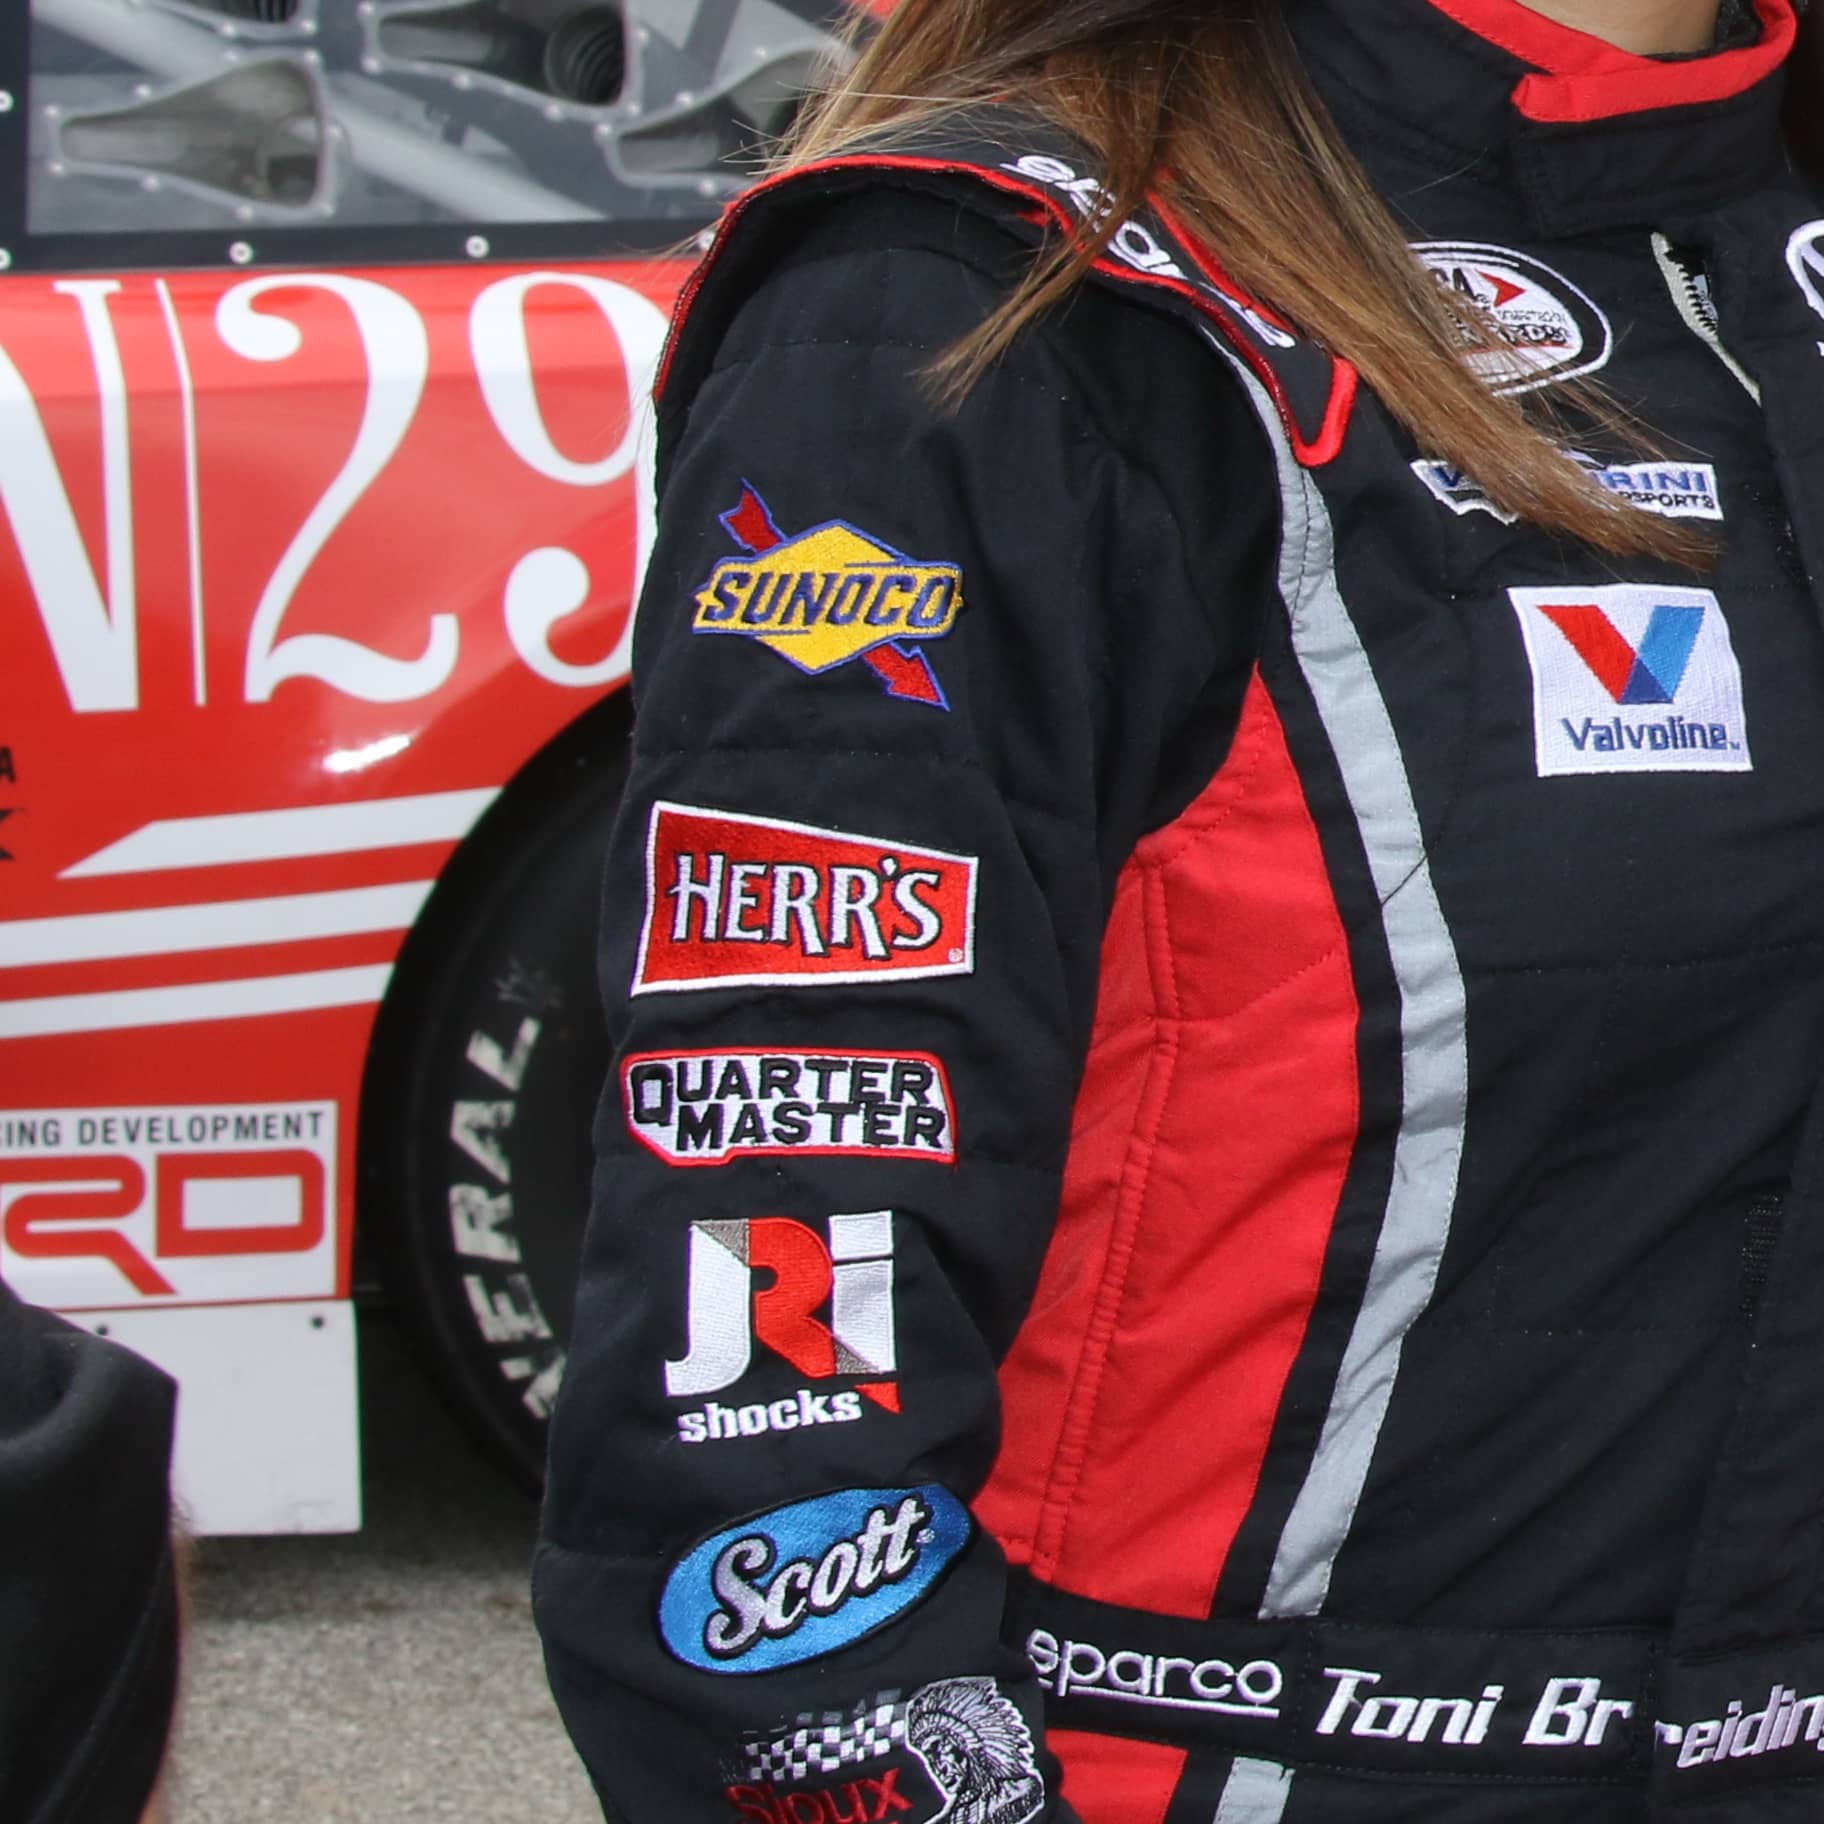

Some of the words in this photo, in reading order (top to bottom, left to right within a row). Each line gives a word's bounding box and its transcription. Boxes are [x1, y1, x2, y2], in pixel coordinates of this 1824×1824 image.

[702, 571, 957, 628] SUNOCO
[1562, 714, 1728, 751] Valvoline
[668, 852, 942, 960] HERR'S
[630, 1056, 935, 1127] QUARTER
[77, 1111, 324, 1146] DEVELOPMENT
[675, 1100, 947, 1153] MASTER
[677, 1385, 863, 1444] shocks
[704, 1495, 930, 1654] Scott
[1025, 1627, 1283, 1697] sparco
[1315, 1667, 1503, 1746] Toni
[725, 1767, 914, 1824] Sioux
